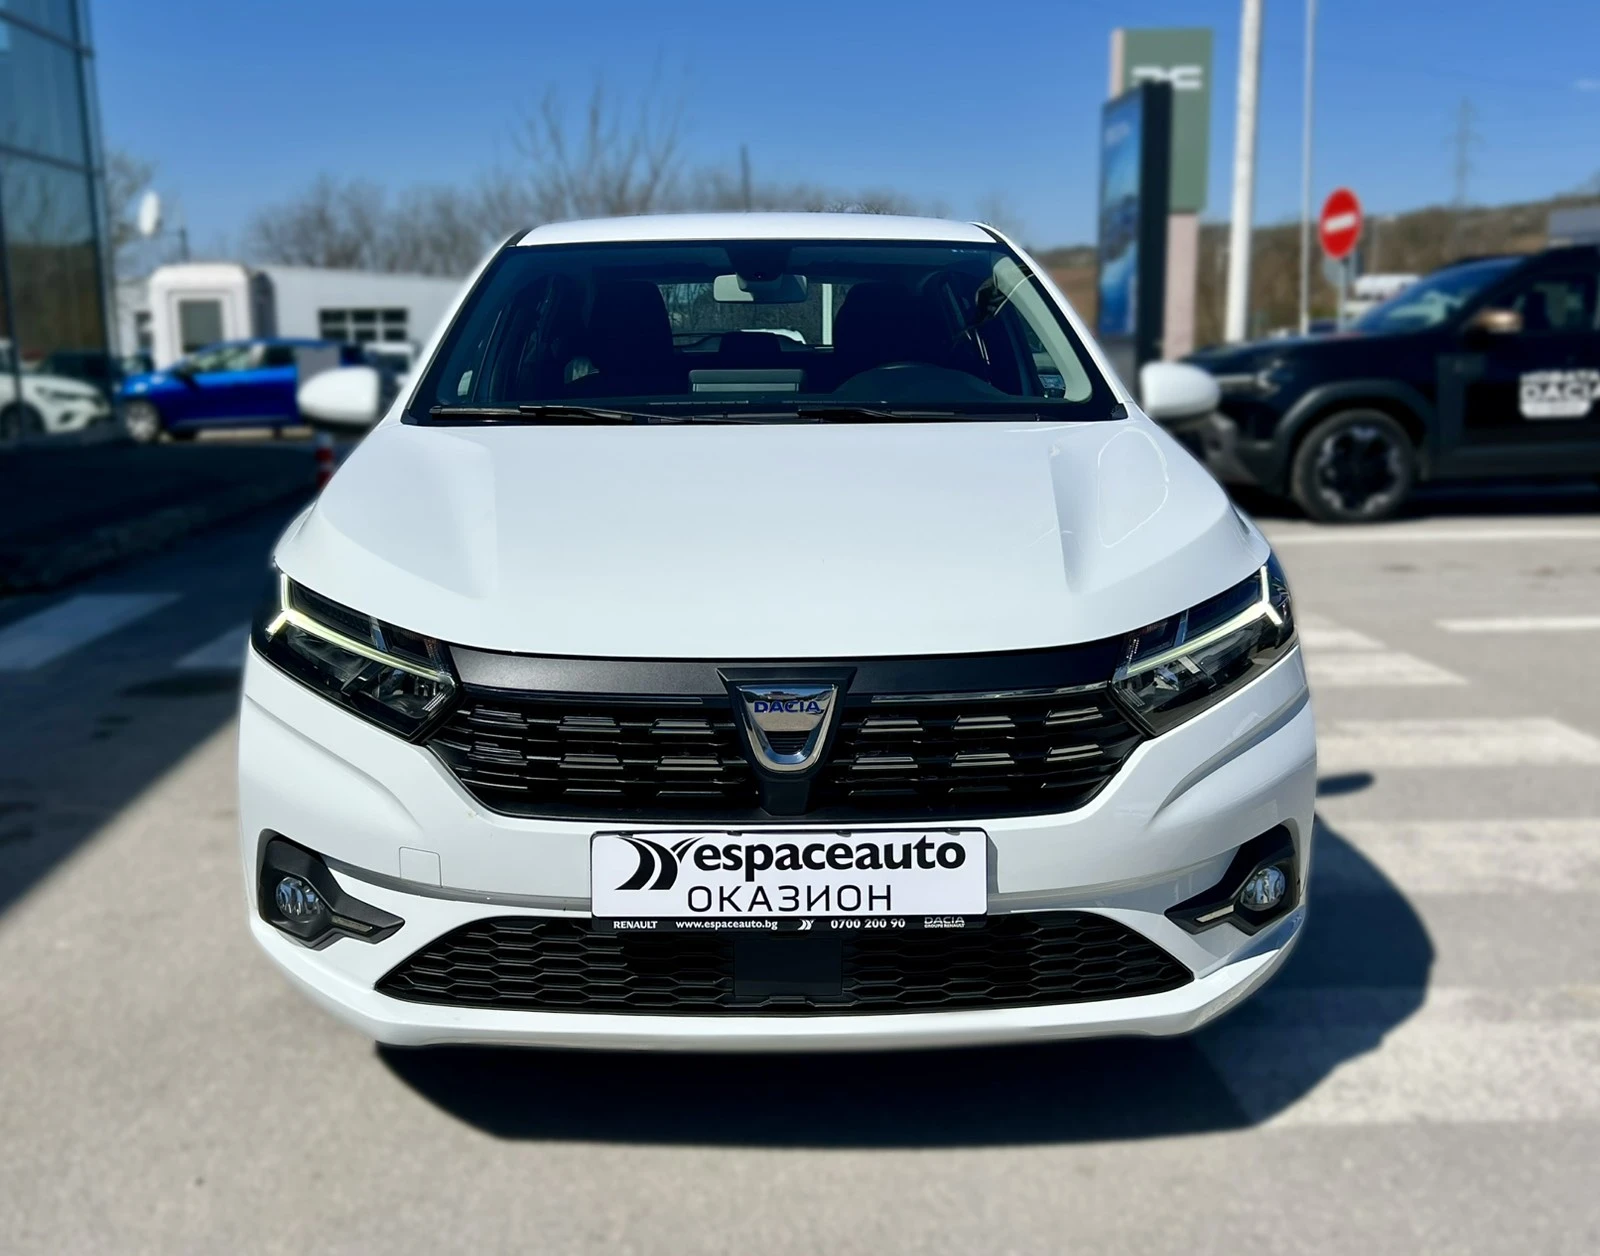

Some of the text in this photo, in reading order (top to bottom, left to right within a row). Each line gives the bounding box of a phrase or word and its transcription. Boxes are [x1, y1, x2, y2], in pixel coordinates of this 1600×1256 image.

[754, 701, 821, 713] DACIA
[693, 835, 967, 882] espaceauto
[687, 885, 892, 912] ОКАЗИОН
[613, 921, 658, 929] RENAULT
[675, 919, 778, 930] www.espaceauto.bg
[830, 919, 906, 929] 0700 200 90
[924, 916, 965, 924] DACIA
